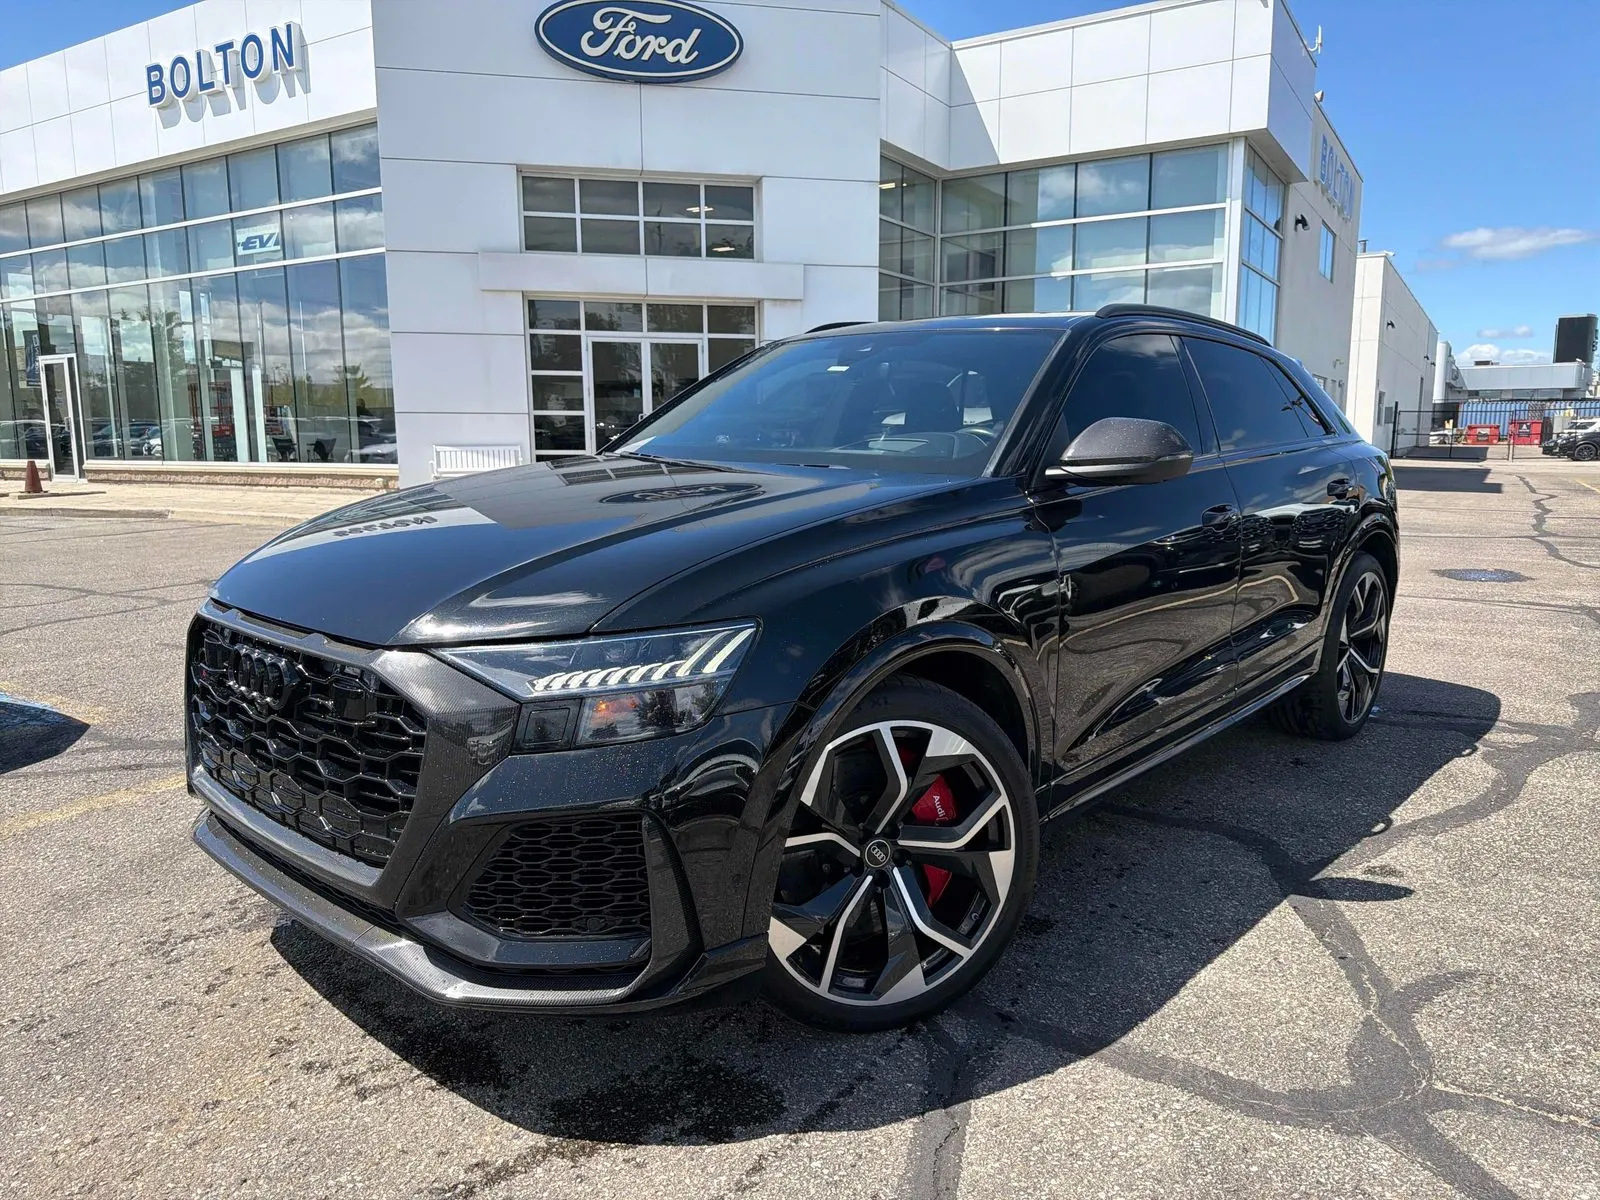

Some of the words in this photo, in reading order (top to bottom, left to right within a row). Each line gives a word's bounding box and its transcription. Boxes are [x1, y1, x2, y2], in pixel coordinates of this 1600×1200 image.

[146, 23, 294, 105] BOLTON
[580, 6, 702, 64] Ford
[933, 795, 946, 817] Audi
